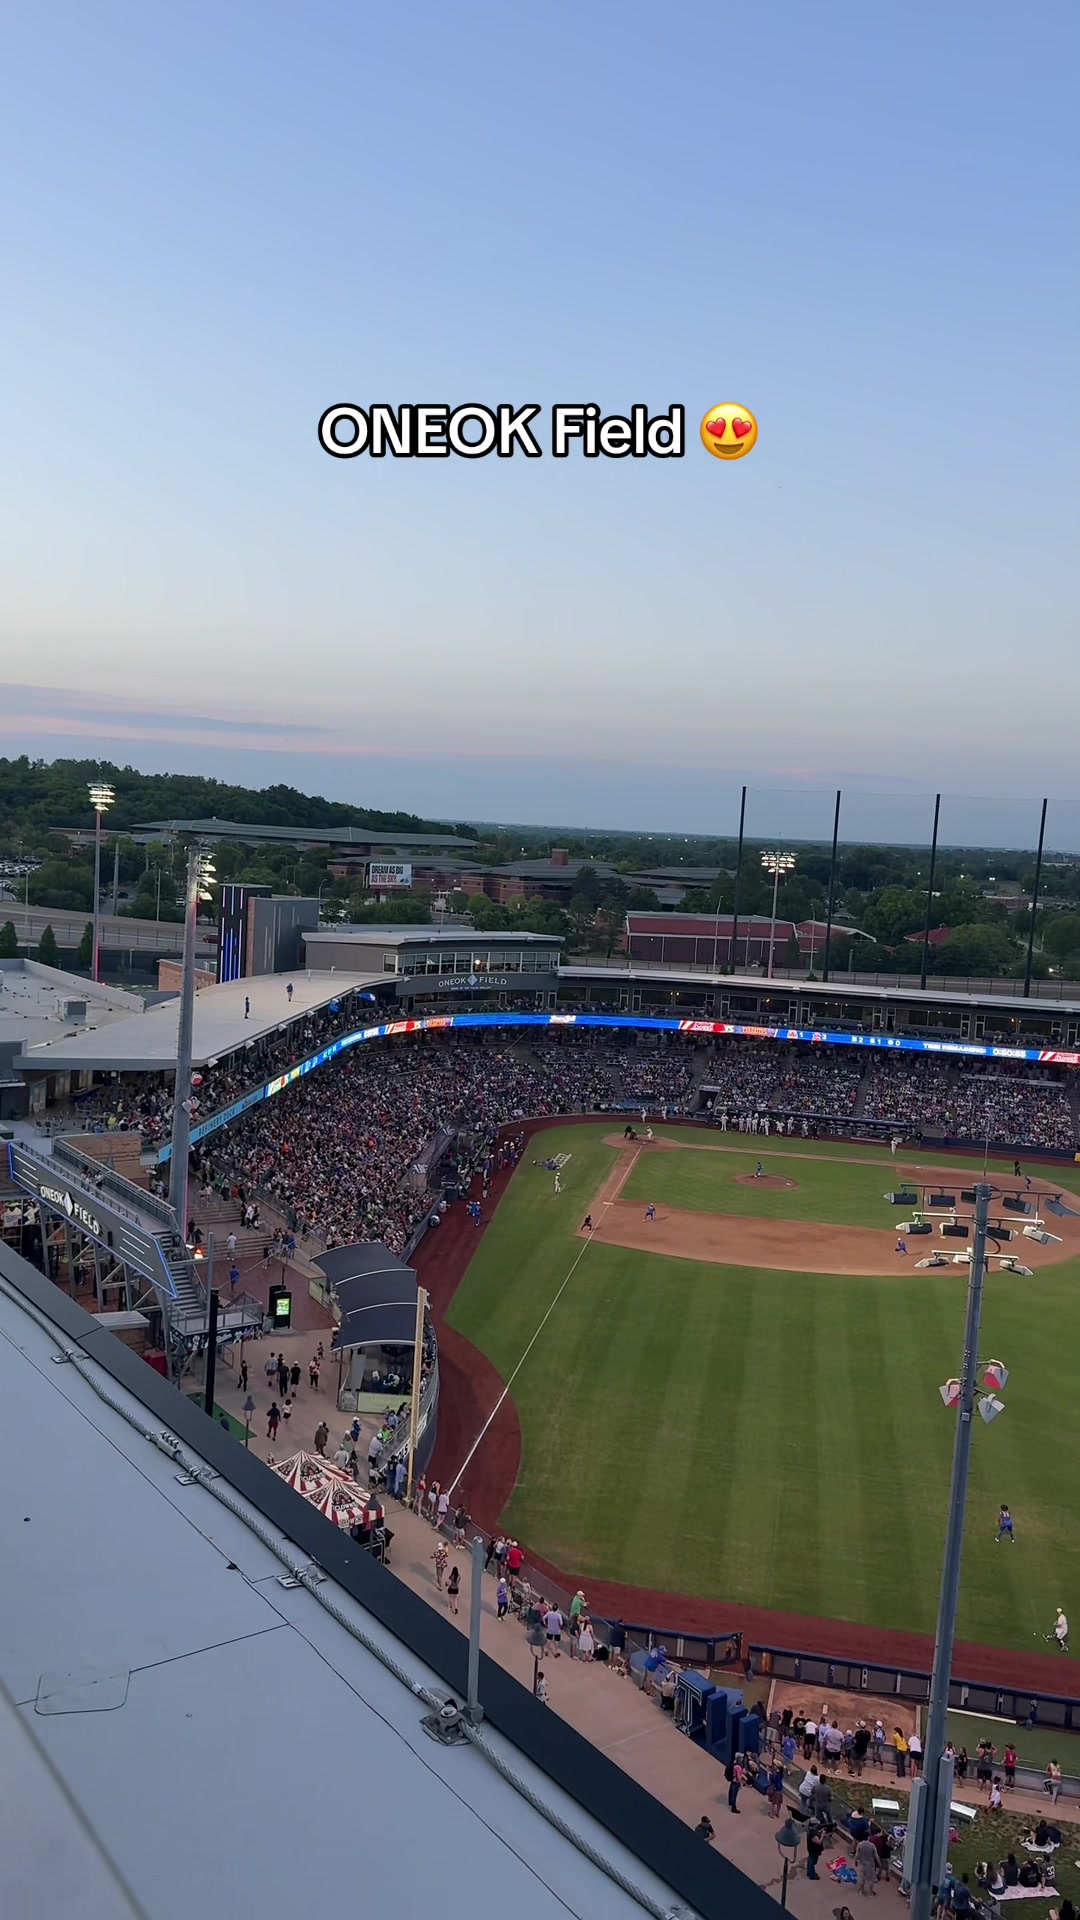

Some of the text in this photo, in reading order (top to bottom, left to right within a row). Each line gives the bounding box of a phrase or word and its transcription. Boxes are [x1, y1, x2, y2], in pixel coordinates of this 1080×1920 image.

[371, 865, 404, 875] DREAM AS BIG
[371, 874, 379, 883] AS
[379, 874, 387, 883] THE
[438, 976, 507, 988] ONEOK FIELD
[922, 1042, 942, 1050] TIME
[198, 1107, 235, 1137] REFINERY DECK
[40, 1185, 100, 1235] ONEOK FIELD
